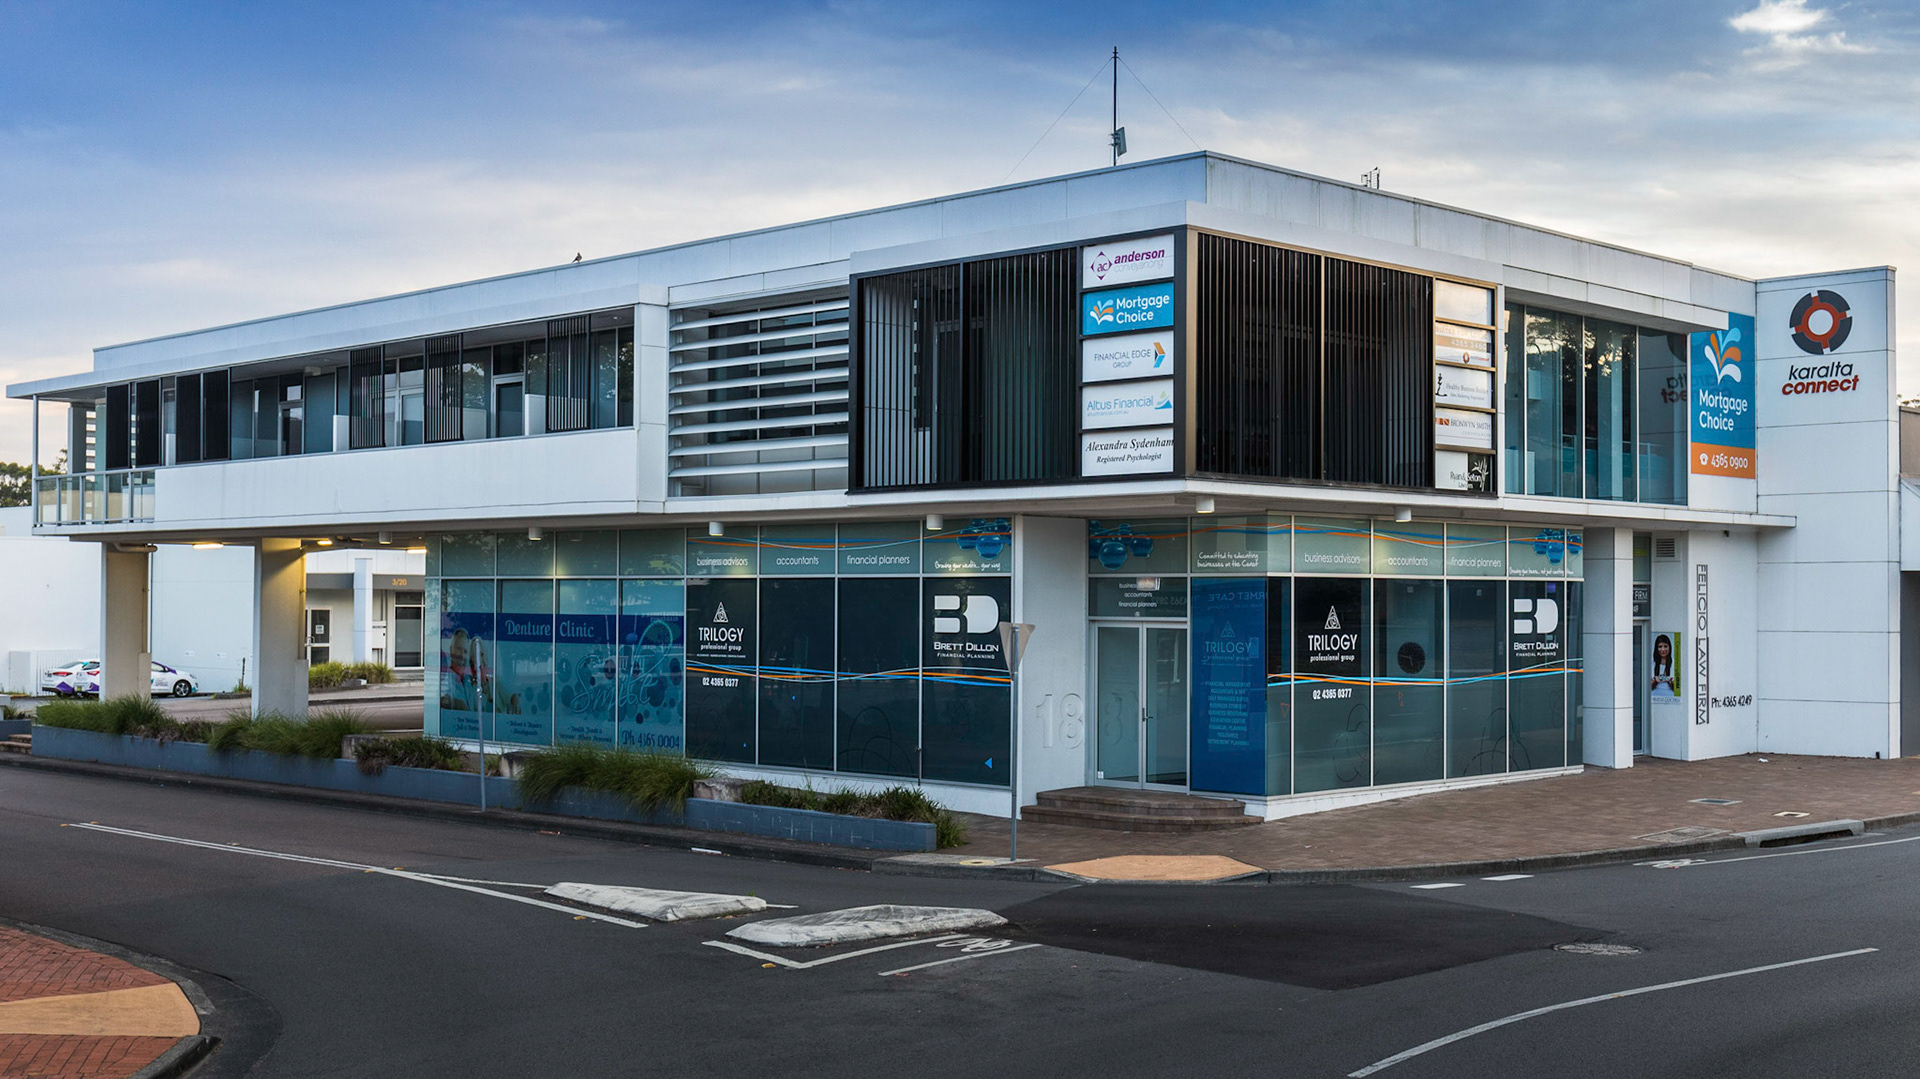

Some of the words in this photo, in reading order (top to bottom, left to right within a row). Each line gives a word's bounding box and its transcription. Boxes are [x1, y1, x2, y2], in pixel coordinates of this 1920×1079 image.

[1114, 249, 1165, 265] anderson
[1116, 295, 1170, 311] Mortgage
[1116, 310, 1154, 324] Choice
[1094, 350, 1130, 361] FINANCIAL
[1131, 348, 1151, 358] EDGE
[1112, 361, 1132, 369] GROUP
[1788, 360, 1853, 381] karalta
[1782, 374, 1860, 396] connect
[1087, 400, 1112, 411] Altus
[1113, 396, 1153, 409] Financial
[1699, 389, 1748, 414] Mortgage
[1450, 418, 1476, 428] BRONWYN
[1476, 421, 1491, 430] SMITH
[1699, 411, 1734, 431] Choice
[1085, 440, 1127, 452] Alexandra
[1130, 437, 1174, 451] Sydenham
[1096, 454, 1126, 464] Registered
[1126, 452, 1162, 463] Psychologist
[1711, 454, 1729, 469] 4365
[1729, 455, 1749, 469] 0900
[697, 557, 722, 566] business
[723, 557, 748, 566] advisors
[776, 556, 819, 566] accountants
[847, 555, 877, 565] financial
[878, 554, 911, 565] planners
[1198, 551, 1227, 559] Committed
[1233, 550, 1259, 560] educating
[1304, 552, 1333, 563] business
[1333, 553, 1361, 564] advisors
[1388, 557, 1429, 566] accountants
[1451, 557, 1476, 567] financial
[1477, 558, 1502, 568] planners
[392, 578, 407, 586] 3/20
[1697, 564, 1706, 631] FELICIO
[505, 619, 552, 636] Denture
[559, 621, 595, 638] Clinic
[698, 627, 745, 642] TRILOGY
[700, 643, 728, 651] professional
[934, 642, 964, 652] BRETT
[966, 642, 999, 652] DILLON
[1205, 641, 1252, 653] TRILOGY
[1307, 634, 1358, 651] TRILOGY
[1513, 641, 1535, 651] BRETT
[1536, 641, 1559, 651] DILLON
[1310, 652, 1340, 663] professional
[1340, 654, 1355, 663] group
[1697, 637, 1706, 677] LAW
[702, 677, 710, 686] 02
[710, 677, 724, 686] 4365
[724, 677, 739, 687] 0377
[1312, 689, 1321, 700] 02
[1321, 689, 1337, 699] 4365
[1337, 688, 1353, 699] 0377
[1697, 683, 1706, 725] FIRM
[1711, 698, 1722, 708] Ph:
[1722, 695, 1737, 708] 4365
[1737, 694, 1753, 706] 4249
[1036, 693, 1085, 749] 18
[622, 731, 635, 746] Ph
[637, 732, 656, 748] 4365
[657, 733, 680, 749] 0004
